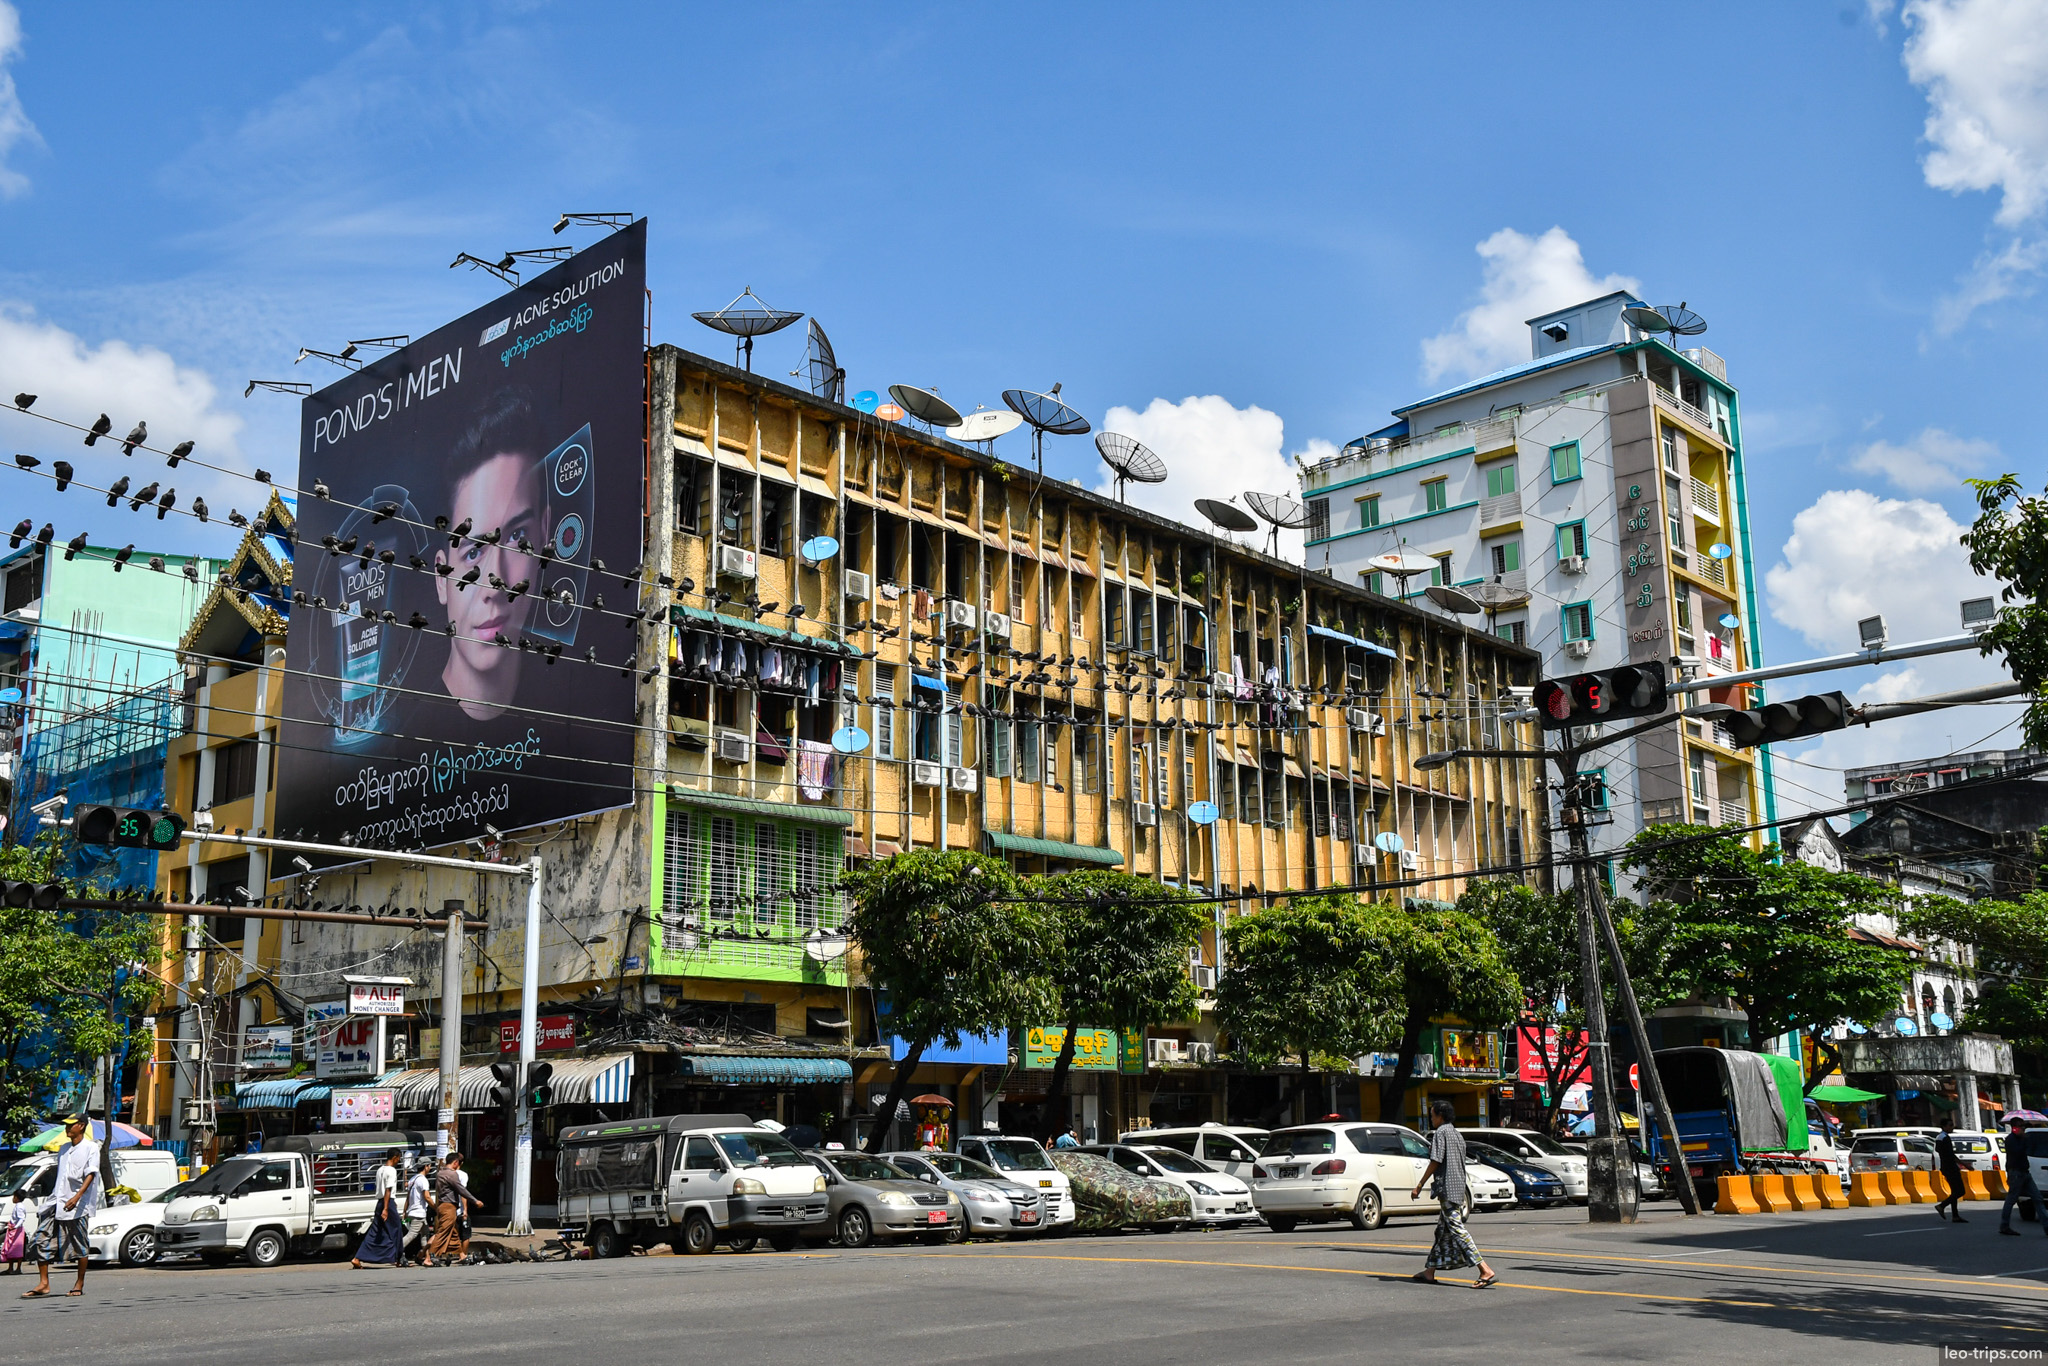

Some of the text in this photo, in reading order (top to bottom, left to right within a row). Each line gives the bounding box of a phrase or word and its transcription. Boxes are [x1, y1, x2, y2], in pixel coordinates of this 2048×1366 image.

[513, 258, 625, 330] ACNE SOLUTION
[405, 347, 463, 408] MEN
[559, 467, 583, 483] CLEAR
[367, 584, 385, 602] MEN
[361, 625, 379, 640] ACNE
[348, 636, 378, 655] SOLUTION
[1589, 685, 1601, 709] 5
[119, 818, 139, 837] 35
[369, 987, 401, 1001] ALIF
[354, 1005, 373, 1013] MONEY
[375, 1005, 400, 1013] CHANGER
[335, 1019, 374, 1047] ALIF
